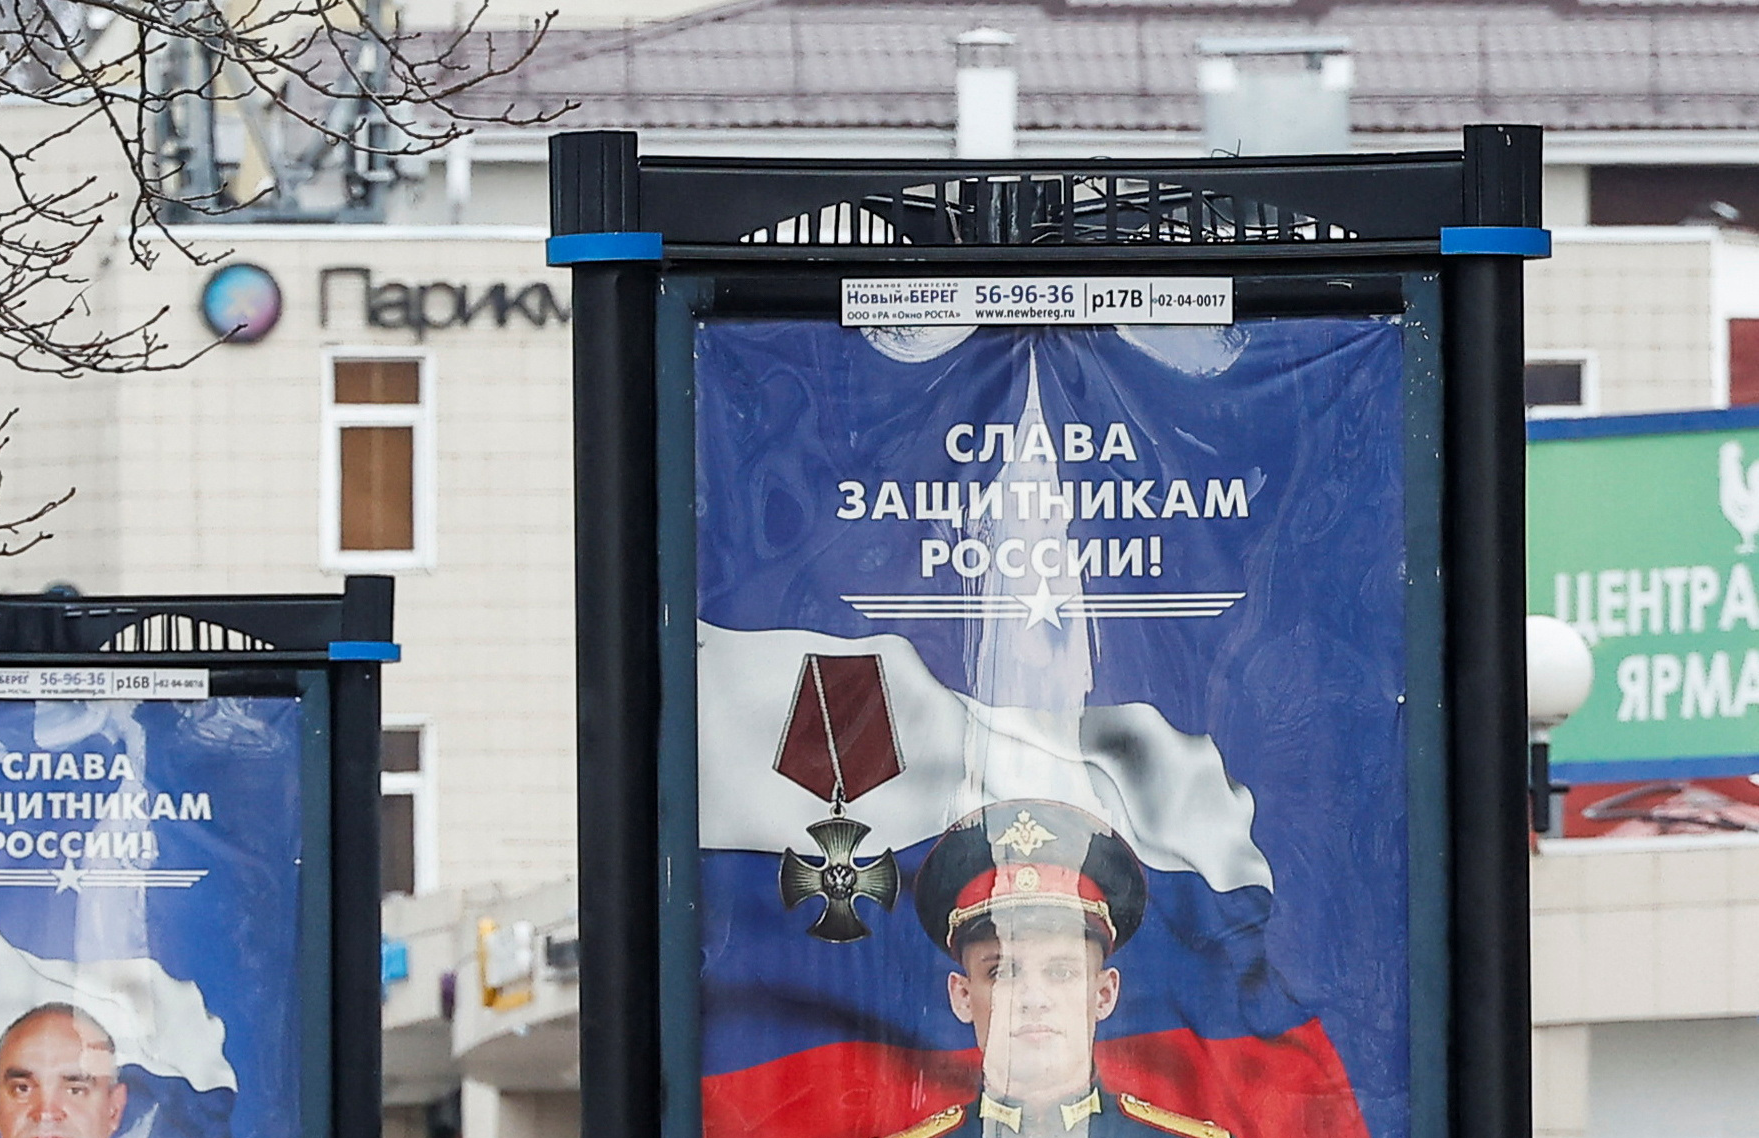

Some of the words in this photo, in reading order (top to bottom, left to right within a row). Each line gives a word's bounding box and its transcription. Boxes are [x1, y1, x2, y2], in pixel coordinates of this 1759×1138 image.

[910, 289, 959, 304] БЕРЕГ
[975, 284, 1075, 305] 56-96-36
[975, 306, 1075, 321] www.newbereg.ru
[945, 422, 1138, 463] СЛАВА
[835, 478, 1249, 529] ЗАЩИТНИКАМ
[921, 536, 1162, 579] РОССИИ!
[39, 672, 106, 686] 56-96-36
[1, 751, 135, 781] СЛАВА
